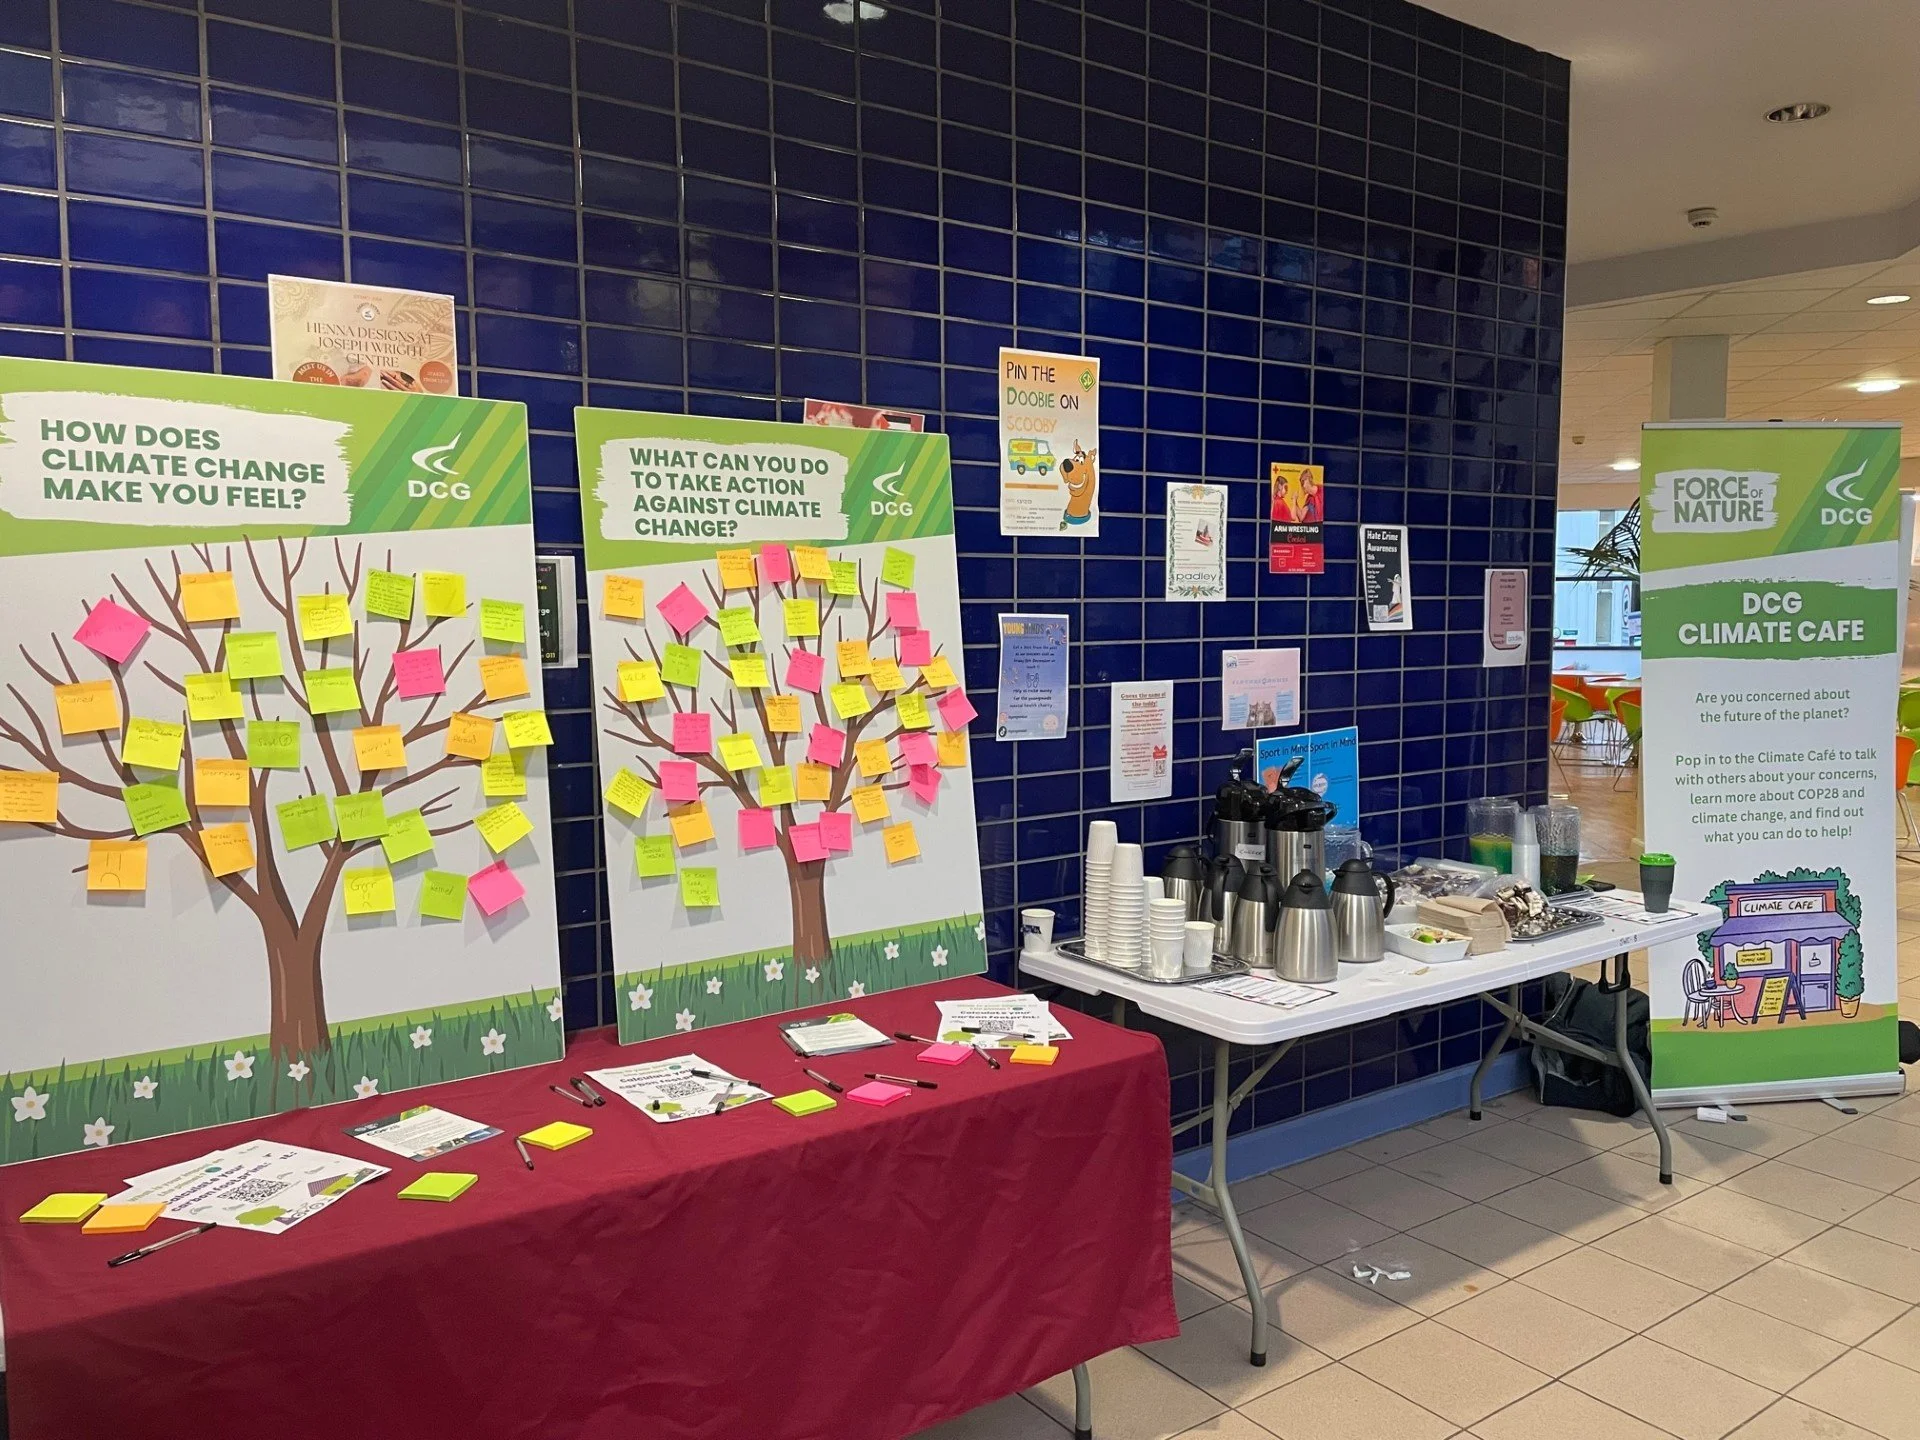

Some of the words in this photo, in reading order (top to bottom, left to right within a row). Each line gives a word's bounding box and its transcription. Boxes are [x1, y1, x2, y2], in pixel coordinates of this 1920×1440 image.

[306, 321, 356, 338] HENNA
[357, 327, 414, 344] DESIGNS
[416, 332, 433, 346] AT
[316, 336, 368, 352] JOSEPH
[371, 341, 425, 359] WRIGHT
[345, 353, 399, 368] CENTRE
[309, 376, 323, 384] THE
[1006, 361, 1027, 380] PIN
[1031, 365, 1056, 383] THE
[1006, 386, 1055, 408] DOOBIE
[1059, 394, 1079, 410] ON
[1006, 415, 1058, 434] SCOOBY
[40, 418, 127, 445] HOW
[135, 424, 221, 451] DOES
[41, 448, 188, 477] CLIMATE
[194, 456, 326, 485] CHANGE
[629, 448, 698, 469] WHAT
[702, 451, 750, 472] CAN
[752, 455, 797, 475] YOU
[800, 457, 829, 476] DO
[43, 477, 143, 503] MAKE
[148, 482, 220, 506] YOU
[226, 486, 307, 510] FEEL?
[407, 479, 472, 501] DCG
[630, 471, 662, 490] TO
[665, 473, 722, 493] TAKE
[726, 476, 805, 497] ACTION
[1673, 476, 1749, 500] FORCE
[1750, 488, 1763, 499] OF
[633, 494, 730, 516] AGAINST
[734, 498, 822, 519] CLIMATE
[870, 500, 914, 517] DCG
[1673, 500, 1764, 523] NATURE
[1821, 507, 1873, 525] DCG
[634, 517, 738, 538] CHANGE?
[1288, 525, 1320, 533] WRESTLING
[1366, 530, 1381, 540] Hate
[1382, 531, 1399, 540] Crime
[1366, 542, 1398, 552] Awareness
[1175, 572, 1217, 582] padley
[1743, 591, 1802, 615] DCG
[1678, 621, 1792, 645] CLIMATE
[1797, 619, 1865, 642] CAFE
[1696, 692, 1718, 704] Are
[1720, 691, 1743, 706] you
[1746, 689, 1811, 703] concerned
[1814, 688, 1850, 700] about
[1700, 710, 1721, 723] the
[1723, 709, 1762, 722] future
[1764, 708, 1778, 721] of
[1779, 707, 1800, 720] the
[1803, 707, 1850, 722] planet?
[1260, 748, 1281, 760] Sport
[1282, 747, 1289, 756] in
[1290, 744, 1309, 757] Mind
[1310, 742, 1330, 753] Sport
[1331, 740, 1338, 749] in
[1339, 737, 1357, 748] Mind
[1675, 754, 1701, 768] Pop
[1704, 754, 1716, 766] in
[1719, 754, 1732, 765] to
[1734, 752, 1755, 765] the
[1757, 750, 1805, 764] Climate
[1807, 749, 1836, 762] Café
[1839, 750, 1852, 761] to
[1855, 748, 1877, 760] talk
[1675, 773, 1704, 786] with
[1706, 771, 1746, 784] others
[1748, 770, 1784, 783] about
[1786, 770, 1816, 784] your
[1818, 768, 1877, 781] concerns,
[1690, 792, 1722, 805] learn
[1725, 792, 1757, 803] more
[1759, 789, 1795, 802] about
[1797, 788, 1839, 800] COP28
[1842, 786, 1865, 799] and
[1691, 810, 1738, 824] climate
[1740, 809, 1787, 824] change,
[1789, 808, 1813, 820] and
[1815, 806, 1840, 819] find
[1843, 806, 1864, 818] out
[1704, 831, 1734, 844] what
[1736, 830, 1759, 845] you
[1762, 828, 1784, 840] can
[1786, 826, 1802, 839] do
[1805, 826, 1818, 838] to
[1821, 825, 1852, 839] help!
[1744, 900, 1783, 913] CLIMATE
[618, 1080, 657, 1089] carbon
[619, 1072, 672, 1083] Calculate
[222, 1163, 245, 1179] your
[171, 1190, 218, 1212] carbon
